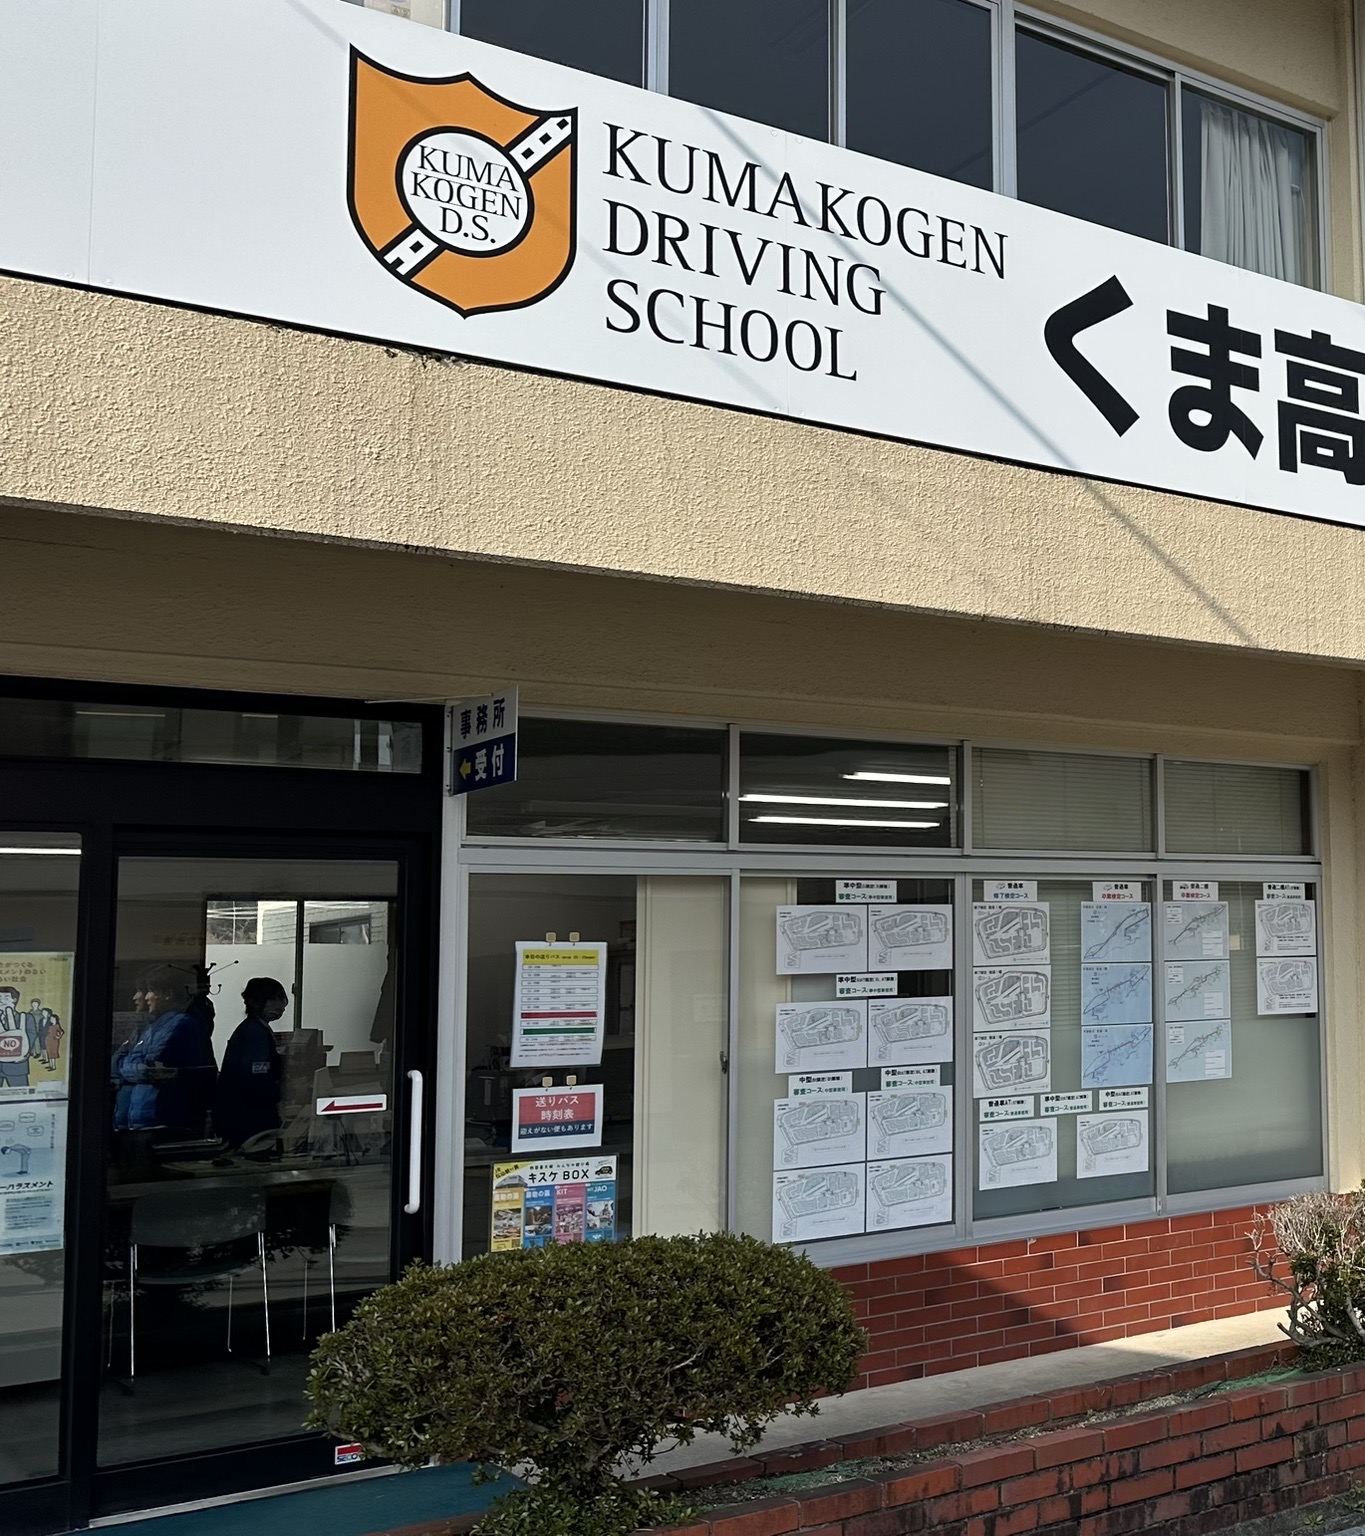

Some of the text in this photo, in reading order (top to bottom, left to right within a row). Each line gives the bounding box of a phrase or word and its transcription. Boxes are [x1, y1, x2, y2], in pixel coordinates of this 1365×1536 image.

[418, 144, 519, 192] KUMA
[410, 171, 522, 220] KOGEN
[602, 121, 1009, 280] KUMAKOGEN
[439, 206, 497, 243] D.S.
[602, 198, 886, 315] DRIVING
[605, 278, 858, 381] SCHOOL
[460, 697, 505, 740] 事務所
[475, 743, 505, 781] 受付
[3, 1039, 17, 1048] NO
[535, 1096, 579, 1108] 送りバス
[541, 1109, 574, 1121] 時刻表
[528, 1171, 558, 1184] キスケ
[562, 1169, 590, 1180] BOX
[556, 1188, 568, 1196] KIT
